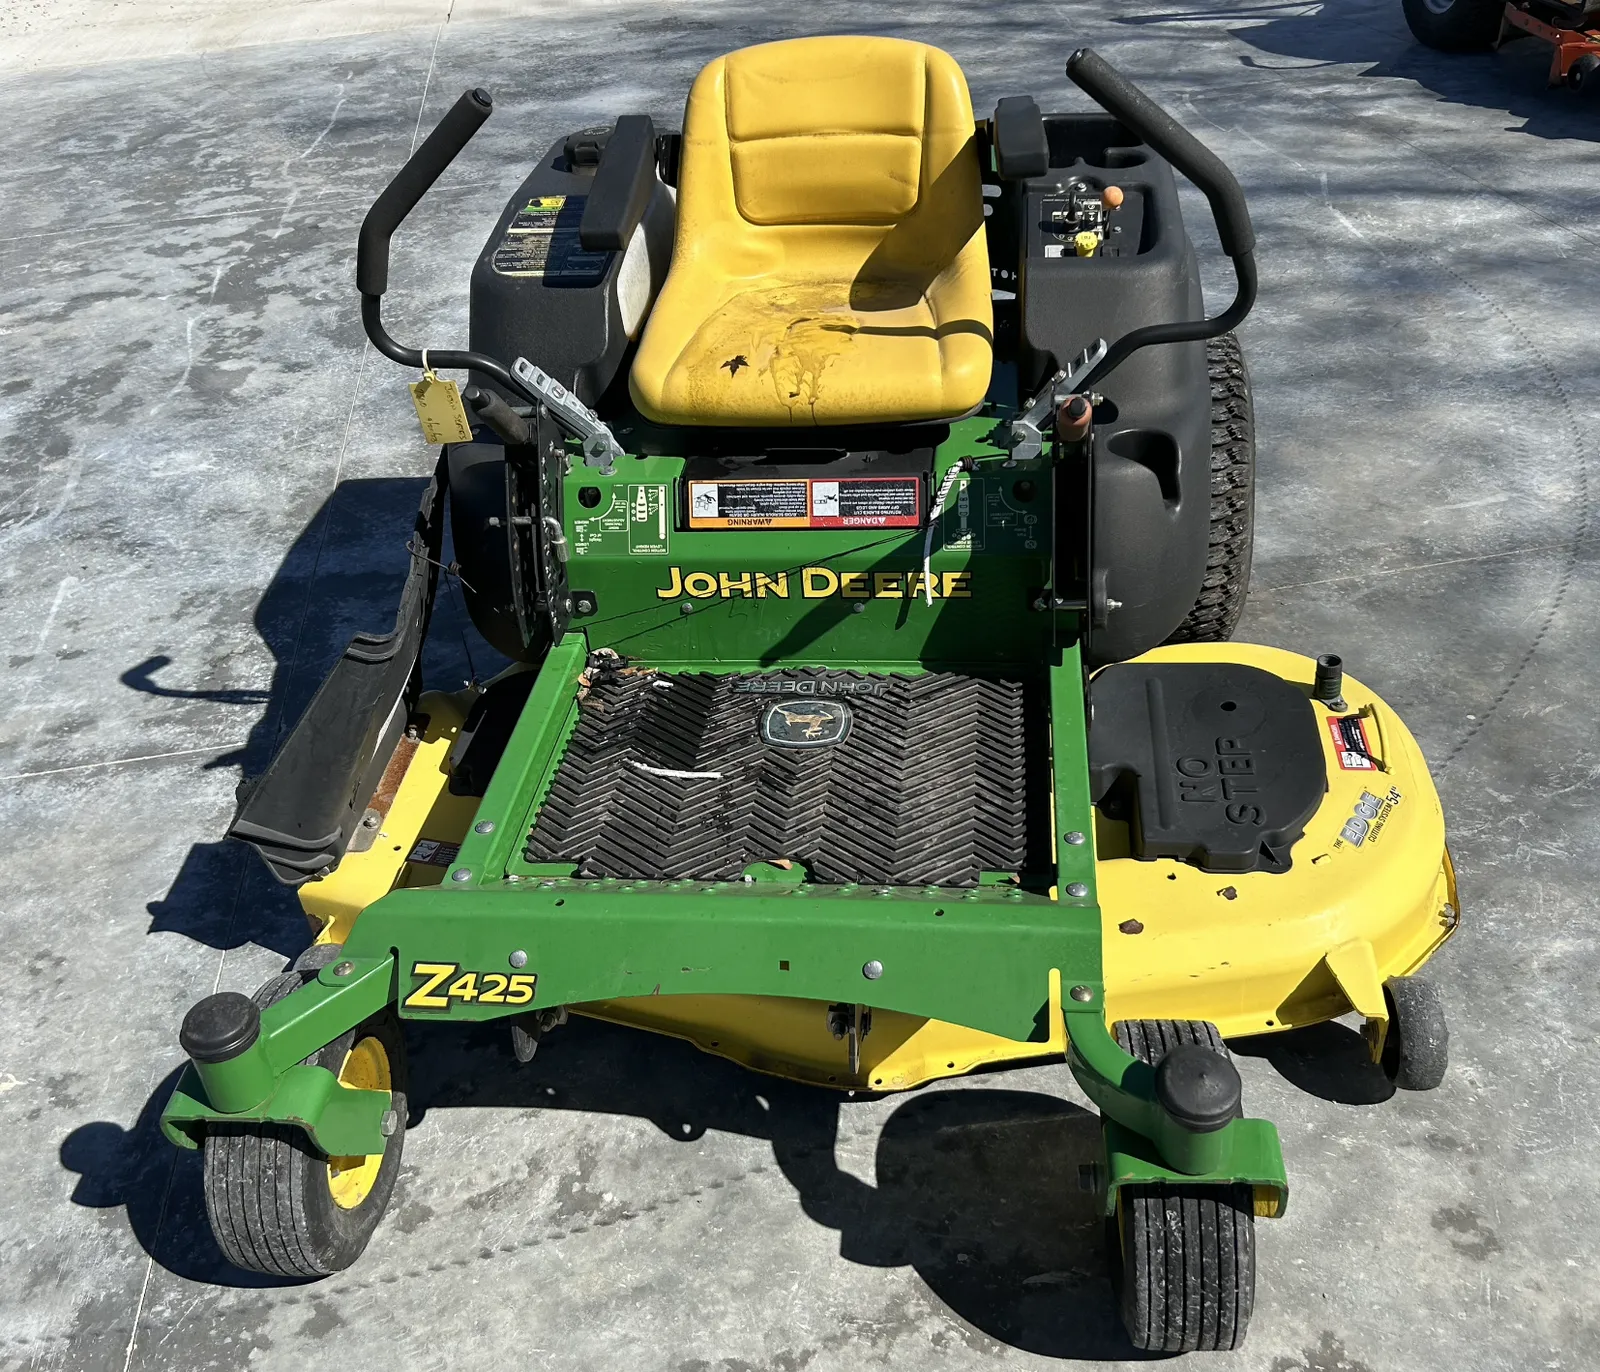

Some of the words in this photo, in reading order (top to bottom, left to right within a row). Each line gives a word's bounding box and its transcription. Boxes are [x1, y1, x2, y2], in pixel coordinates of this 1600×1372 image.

[727, 518, 765, 526] WARNING
[842, 517, 878, 525] DANGER
[656, 566, 790, 599] JOHN
[801, 566, 972, 599] DEERE
[735, 680, 815, 695] DEERE
[821, 680, 890, 696] JOHN
[1176, 756, 1216, 803] NO
[1215, 736, 1267, 826] STEP
[1333, 838, 1343, 849] THE
[1340, 791, 1385, 848] EDGE
[1368, 822, 1384, 843] CUTTING
[1379, 803, 1393, 823] SYSTEM
[1386, 786, 1401, 805] 54"
[403, 961, 538, 1009] Z425
